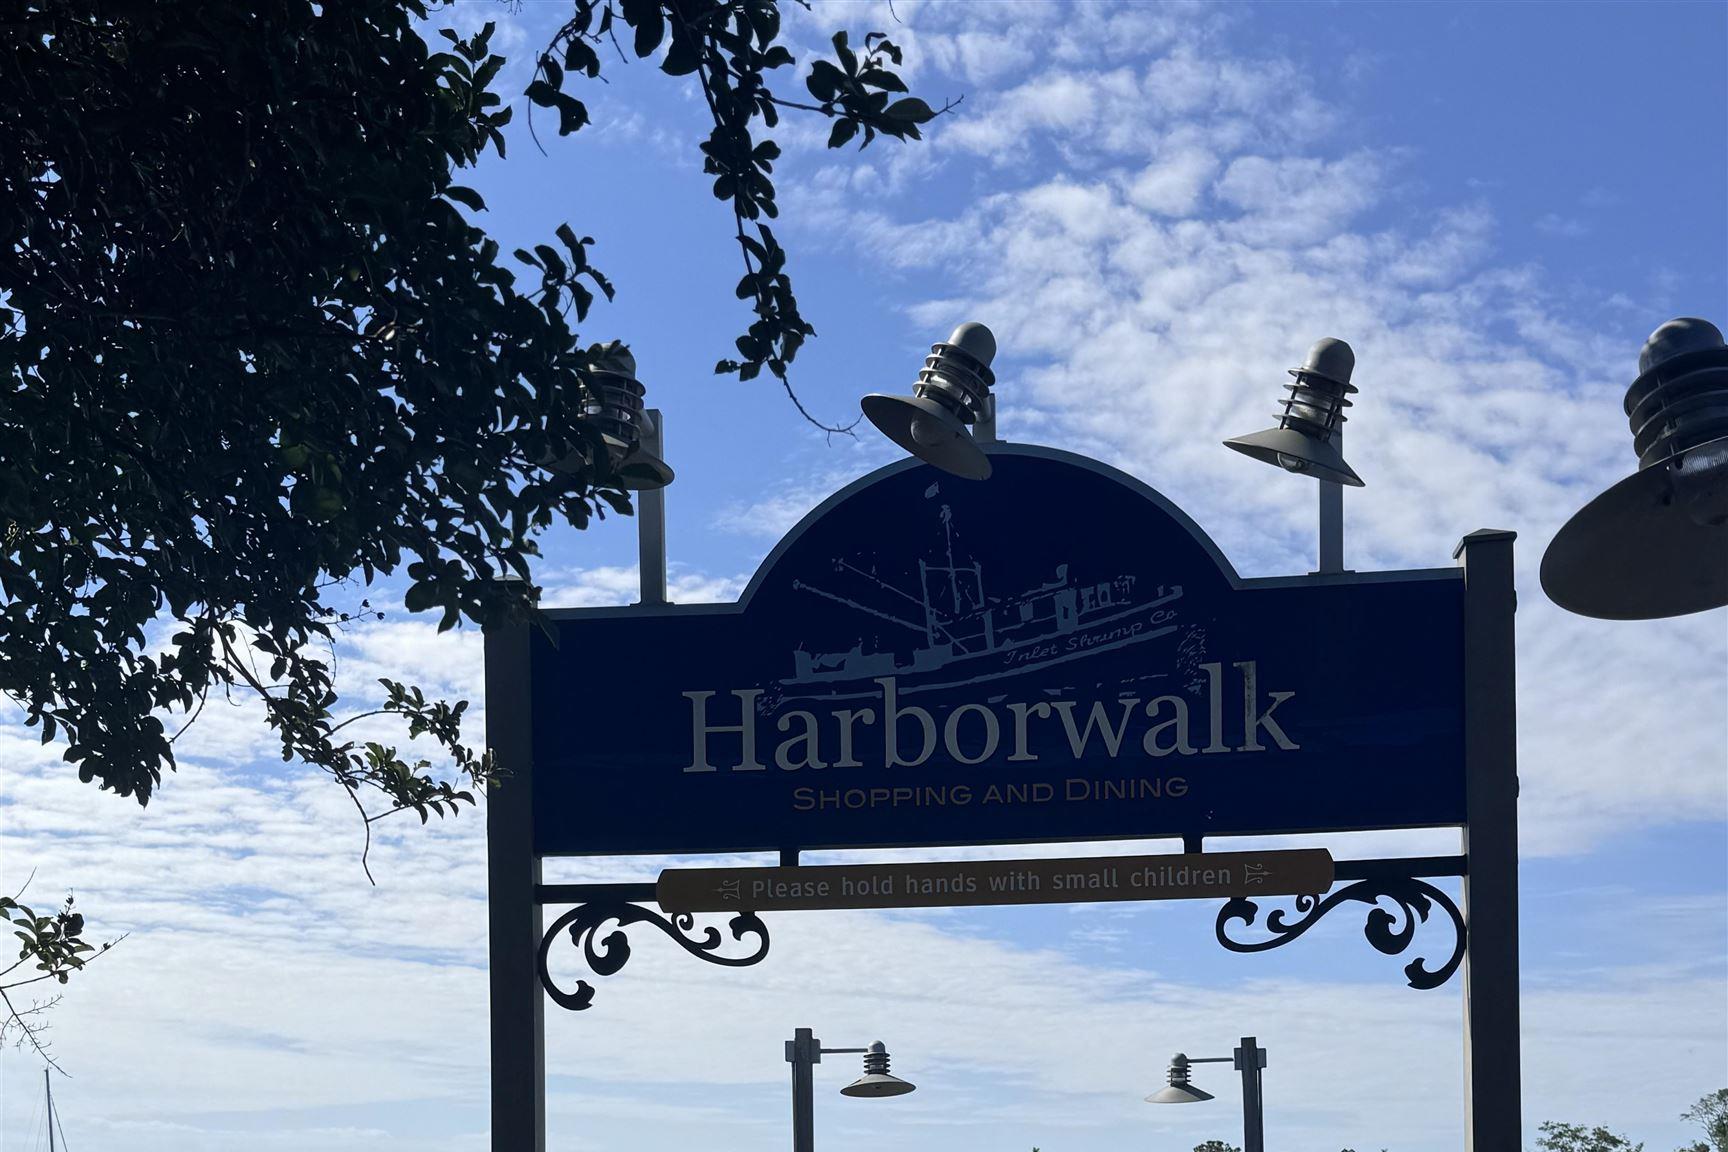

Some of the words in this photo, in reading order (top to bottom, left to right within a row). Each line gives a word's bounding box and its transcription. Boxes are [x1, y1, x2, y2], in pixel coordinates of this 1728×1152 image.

[1003, 643, 1058, 665] Inlet
[1150, 609, 1178, 625] Co
[682, 660, 1300, 773] Harborwalk
[792, 784, 973, 811] SHOPPING
[981, 782, 1055, 805] AND
[1064, 776, 1190, 801] DINING
[752, 879, 831, 899] Please
[841, 875, 895, 897] hold
[905, 872, 978, 896] hands
[989, 871, 1041, 893] with
[1052, 867, 1120, 890] small
[1130, 865, 1232, 888] children
